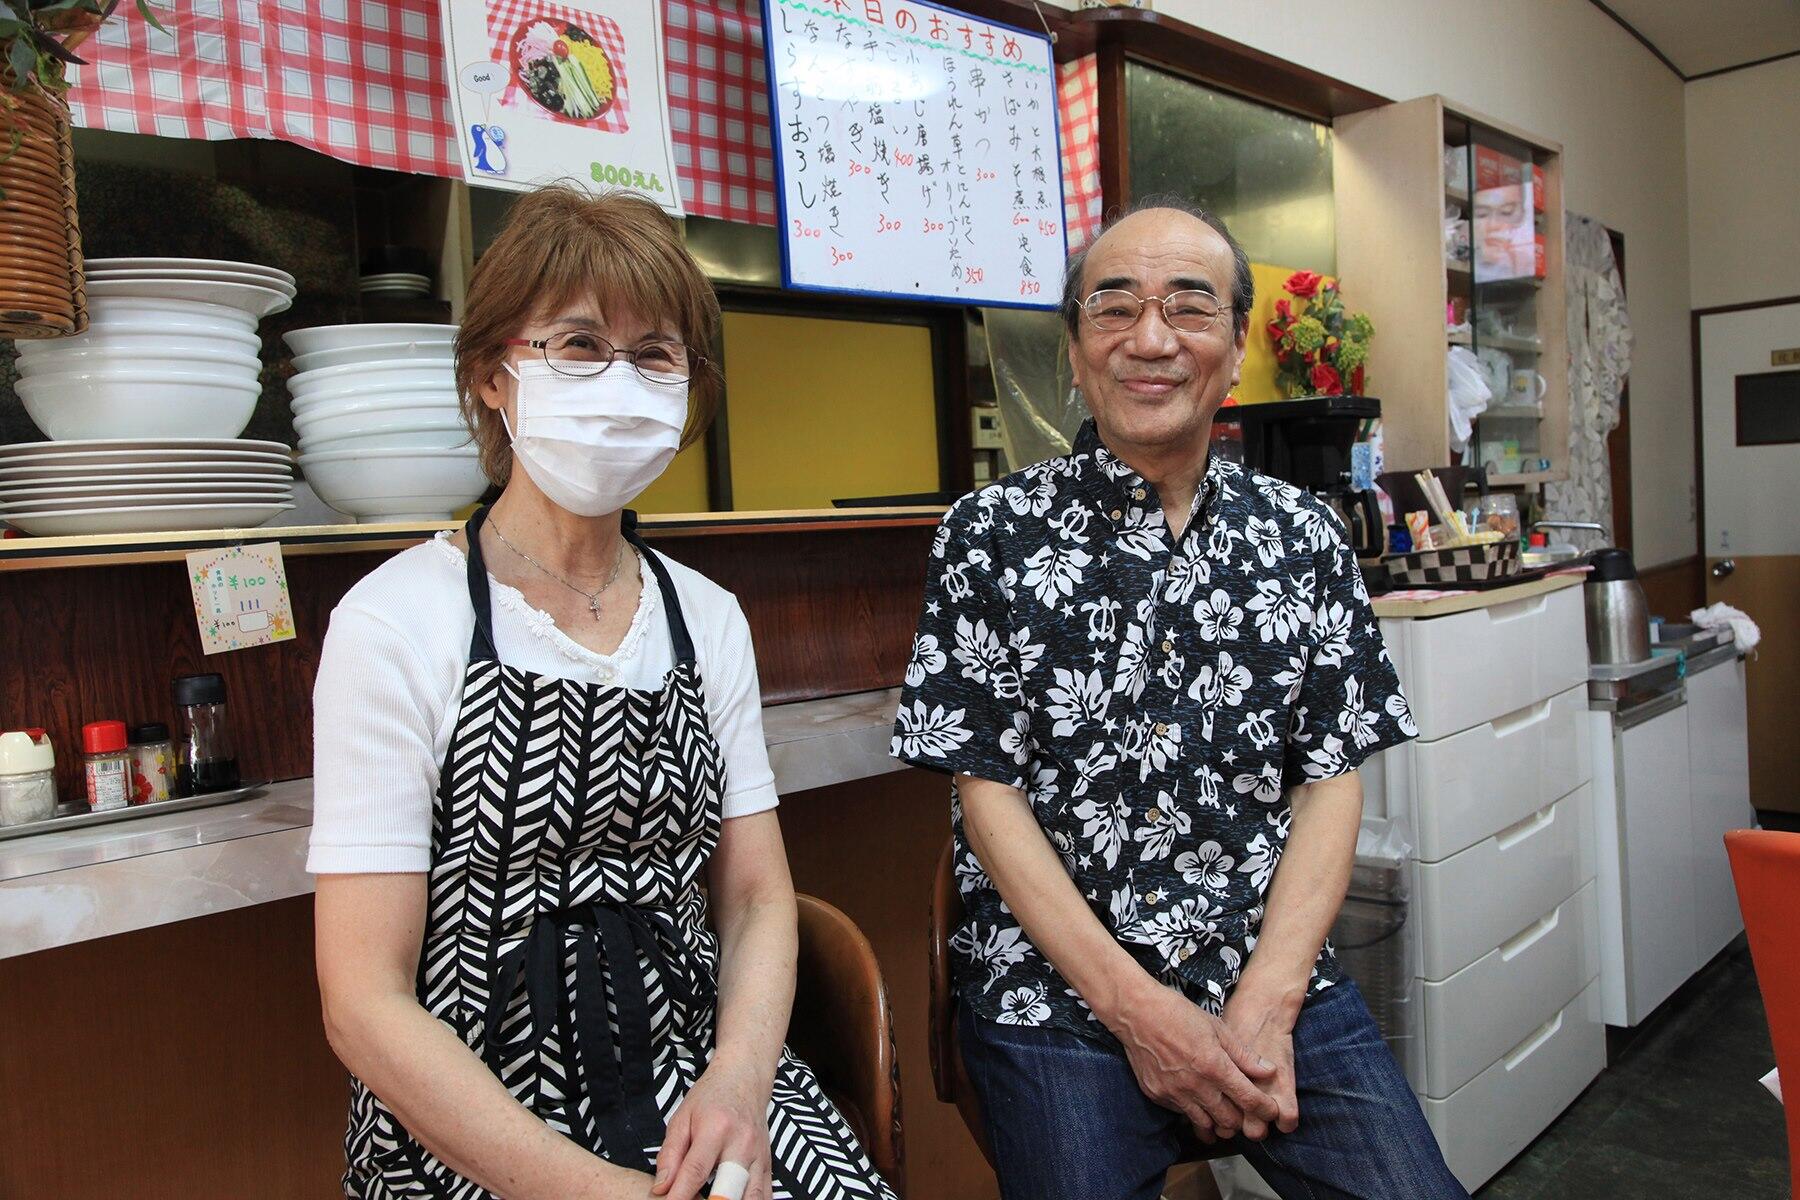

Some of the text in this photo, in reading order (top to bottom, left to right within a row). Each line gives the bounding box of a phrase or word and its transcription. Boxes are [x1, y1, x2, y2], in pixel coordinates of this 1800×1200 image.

[473, 73, 490, 82] Good
[779, 8, 821, 237] しらすおろし 300
[894, 147, 914, 168] 400
[848, 159, 871, 176] 300
[976, 167, 996, 182] 300
[590, 161, 664, 192] 800えん
[877, 213, 901, 233] 300
[923, 218, 944, 233] 300
[831, 246, 853, 266] 300
[965, 267, 984, 284] 350
[1020, 280, 1041, 295] 850
